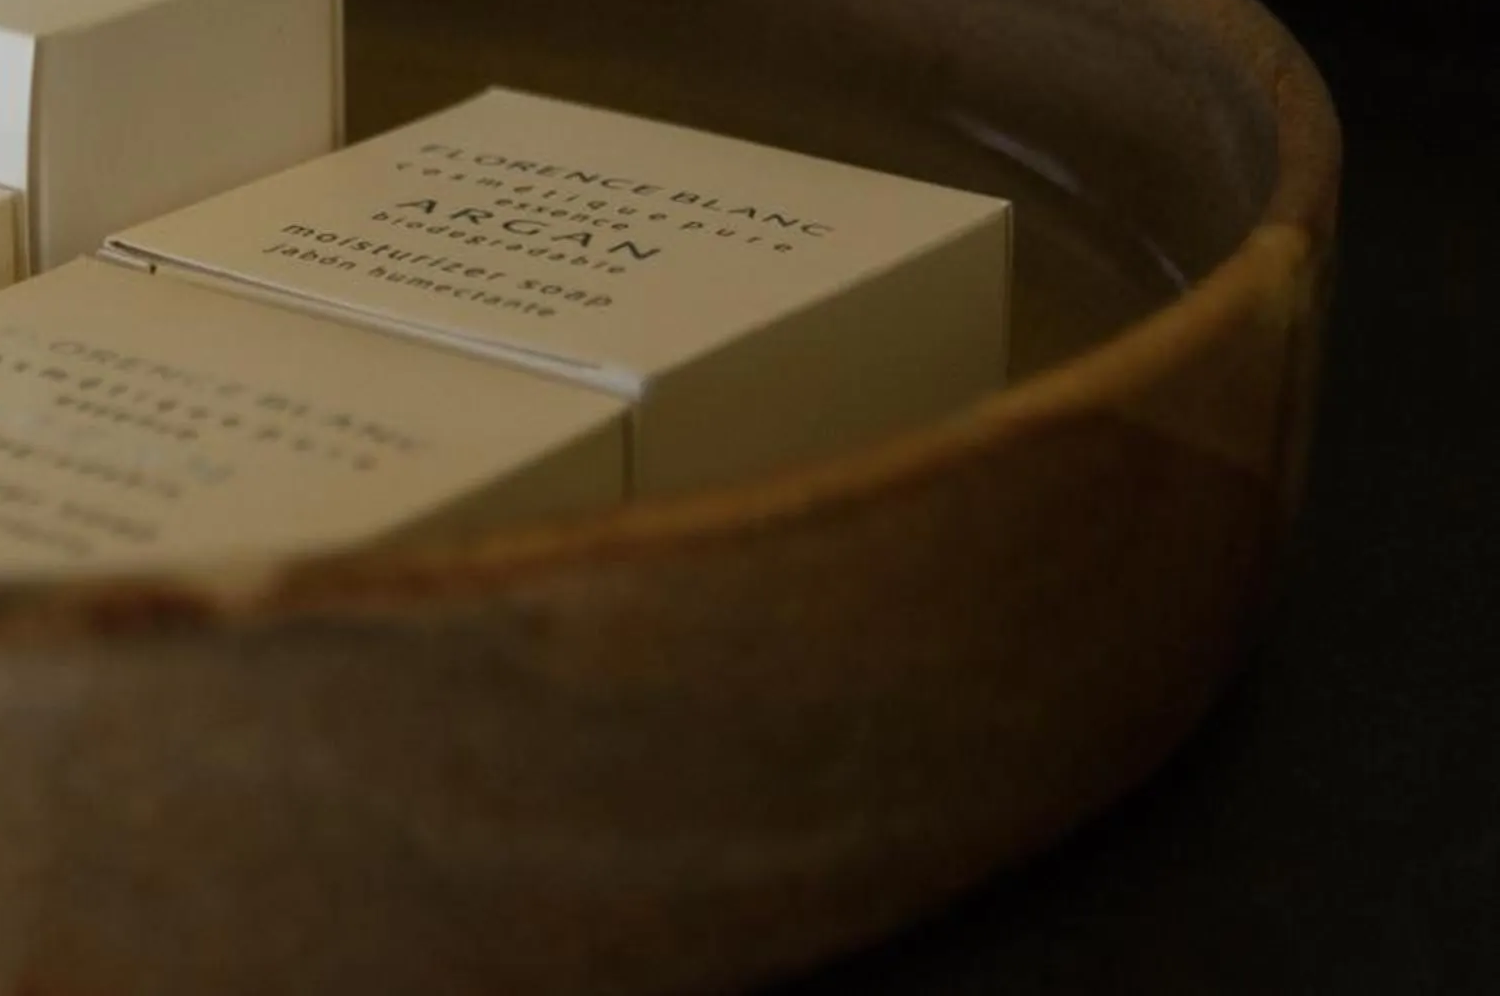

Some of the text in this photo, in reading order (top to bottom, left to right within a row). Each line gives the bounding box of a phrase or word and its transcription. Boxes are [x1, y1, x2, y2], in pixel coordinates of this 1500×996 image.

[420, 143, 836, 237] FLORENCE BLANC
[370, 210, 627, 274] biodegradable
[395, 198, 662, 260] ARGAN
[679, 220, 794, 253] pure
[280, 223, 613, 308] moisturizer soap
[367, 264, 556, 317] humectante
